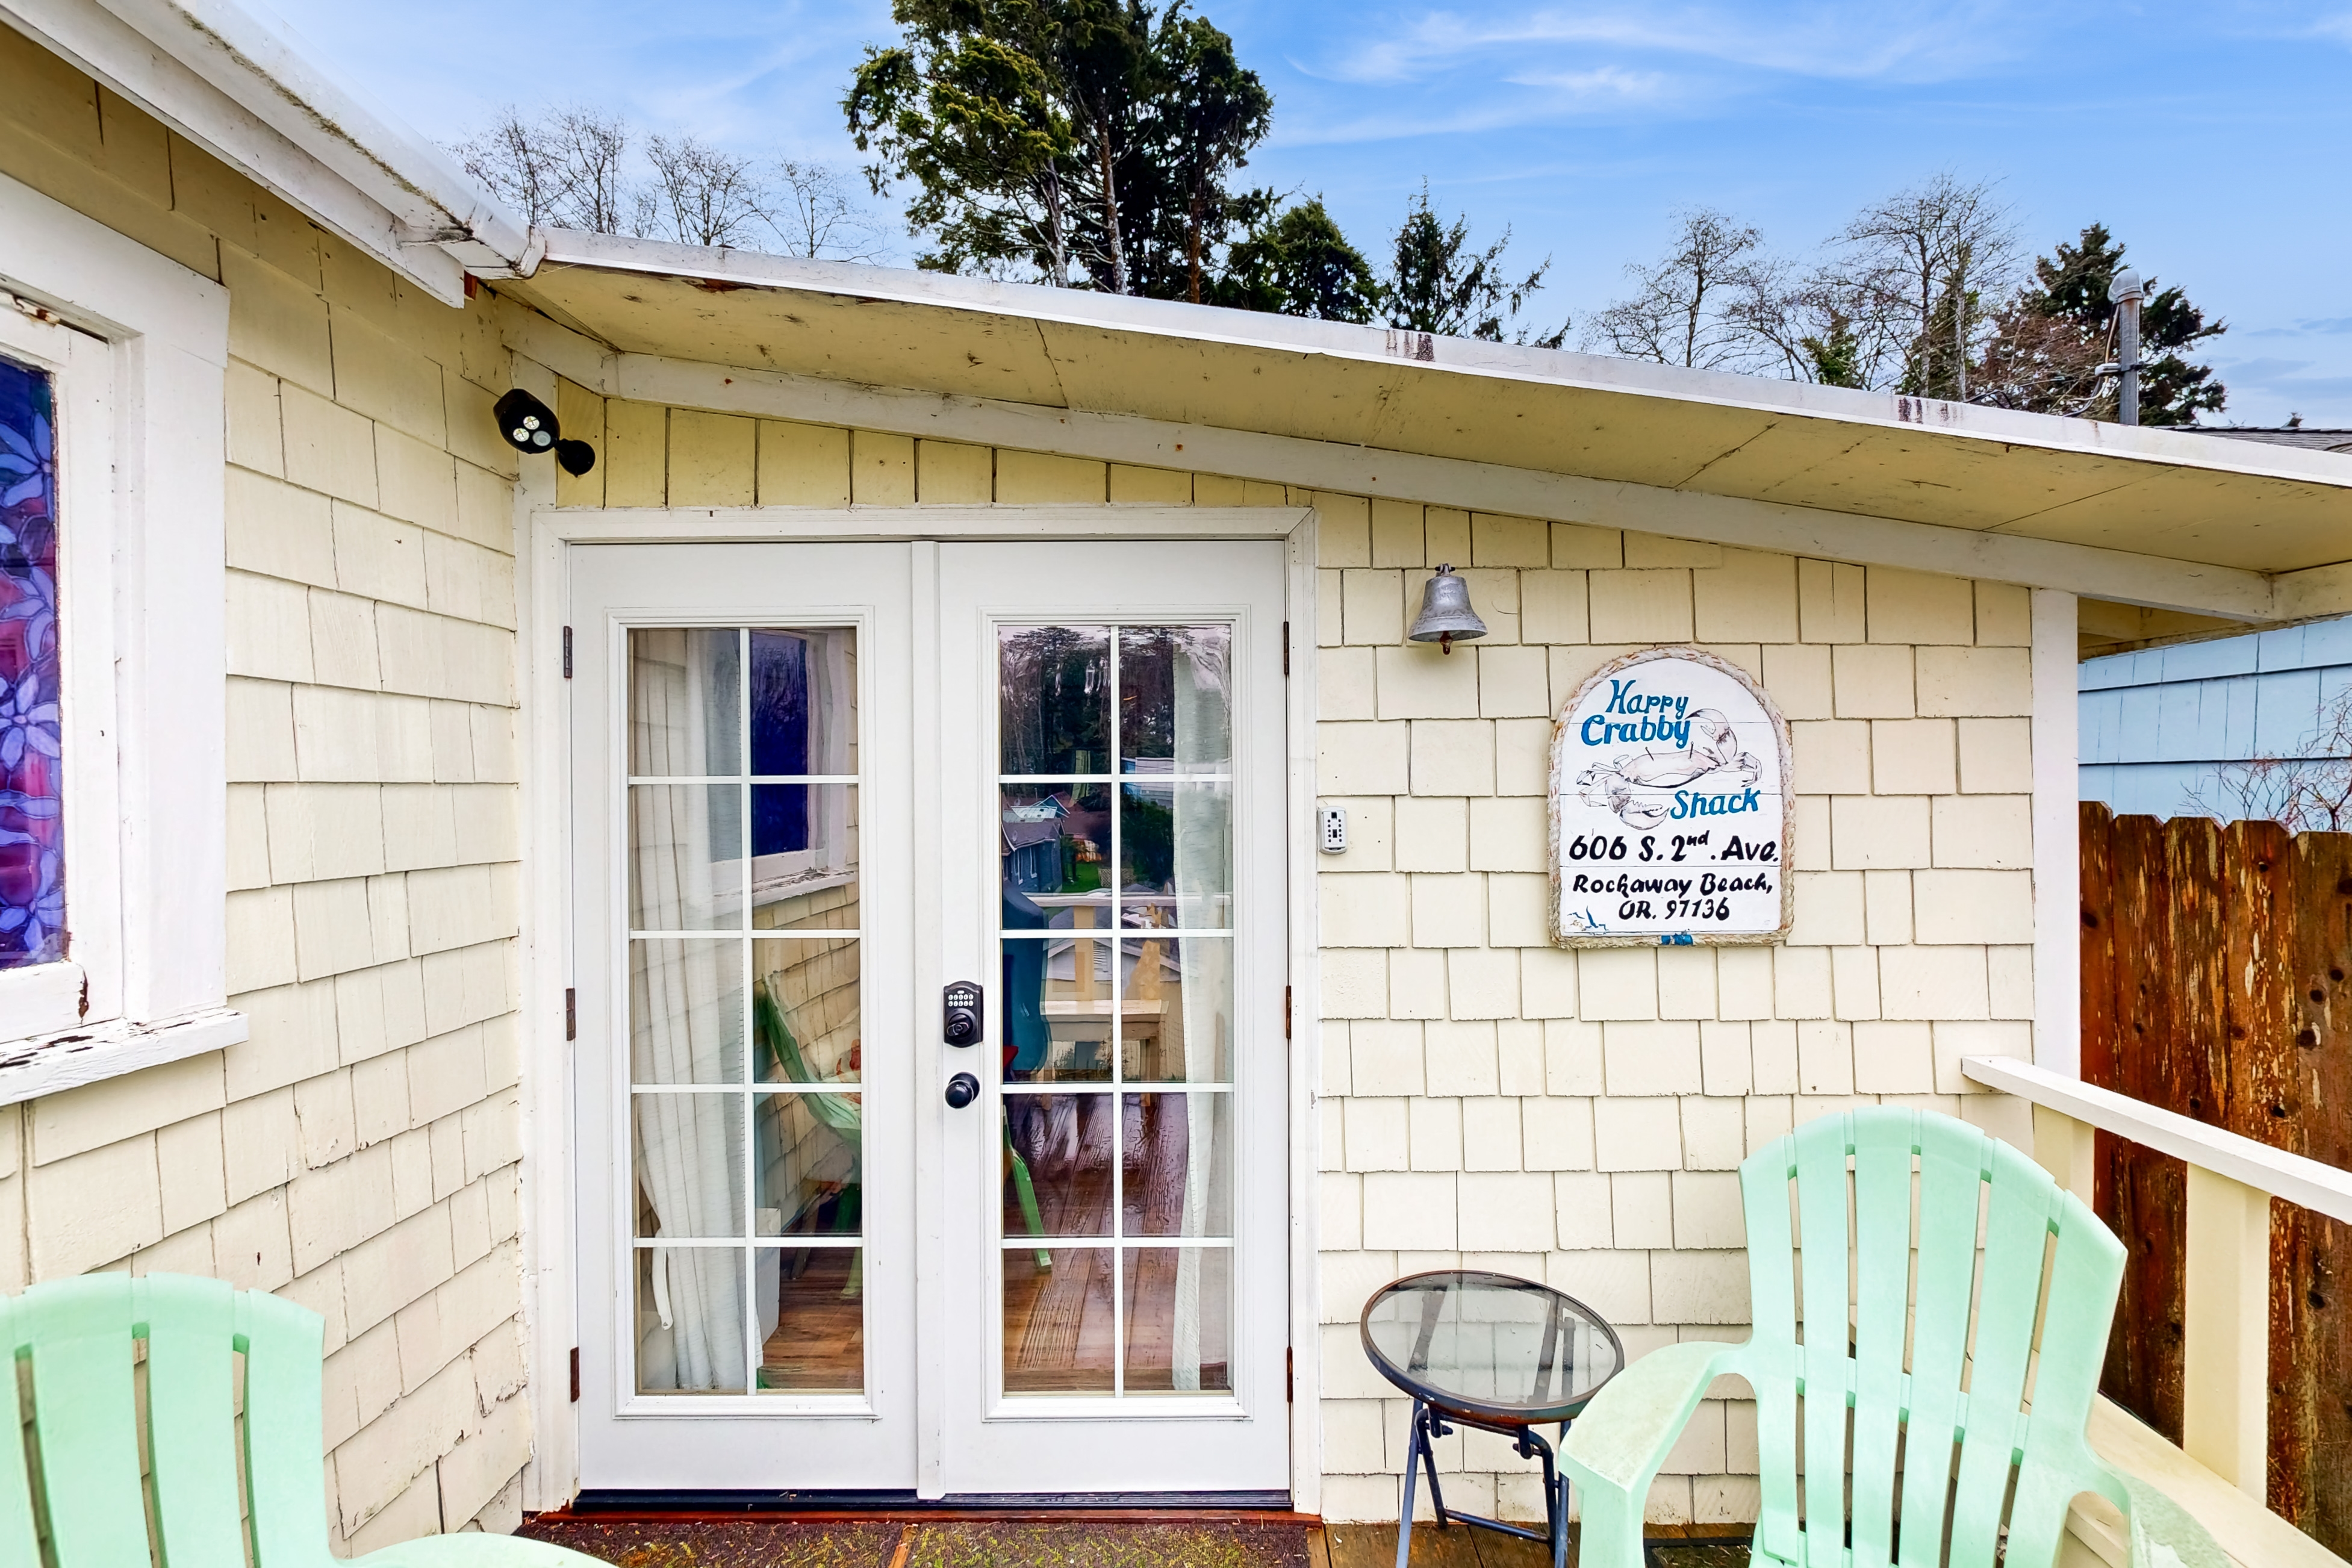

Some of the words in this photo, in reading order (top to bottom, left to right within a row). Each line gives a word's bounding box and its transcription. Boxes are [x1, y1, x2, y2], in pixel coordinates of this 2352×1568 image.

[1605, 679, 1689, 718] Happy
[1581, 714, 1691, 748] Crabby
[1670, 787, 1761, 820] Shack
[1569, 835, 1627, 860] 606
[1638, 835, 1663, 862] S.
[1720, 835, 1779, 862] Ave.
[1573, 873, 1693, 898] Rockaway
[1700, 873, 1773, 895] Beach,
[1619, 900, 1657, 920] OR.
[1664, 897, 1729, 921] 97136
